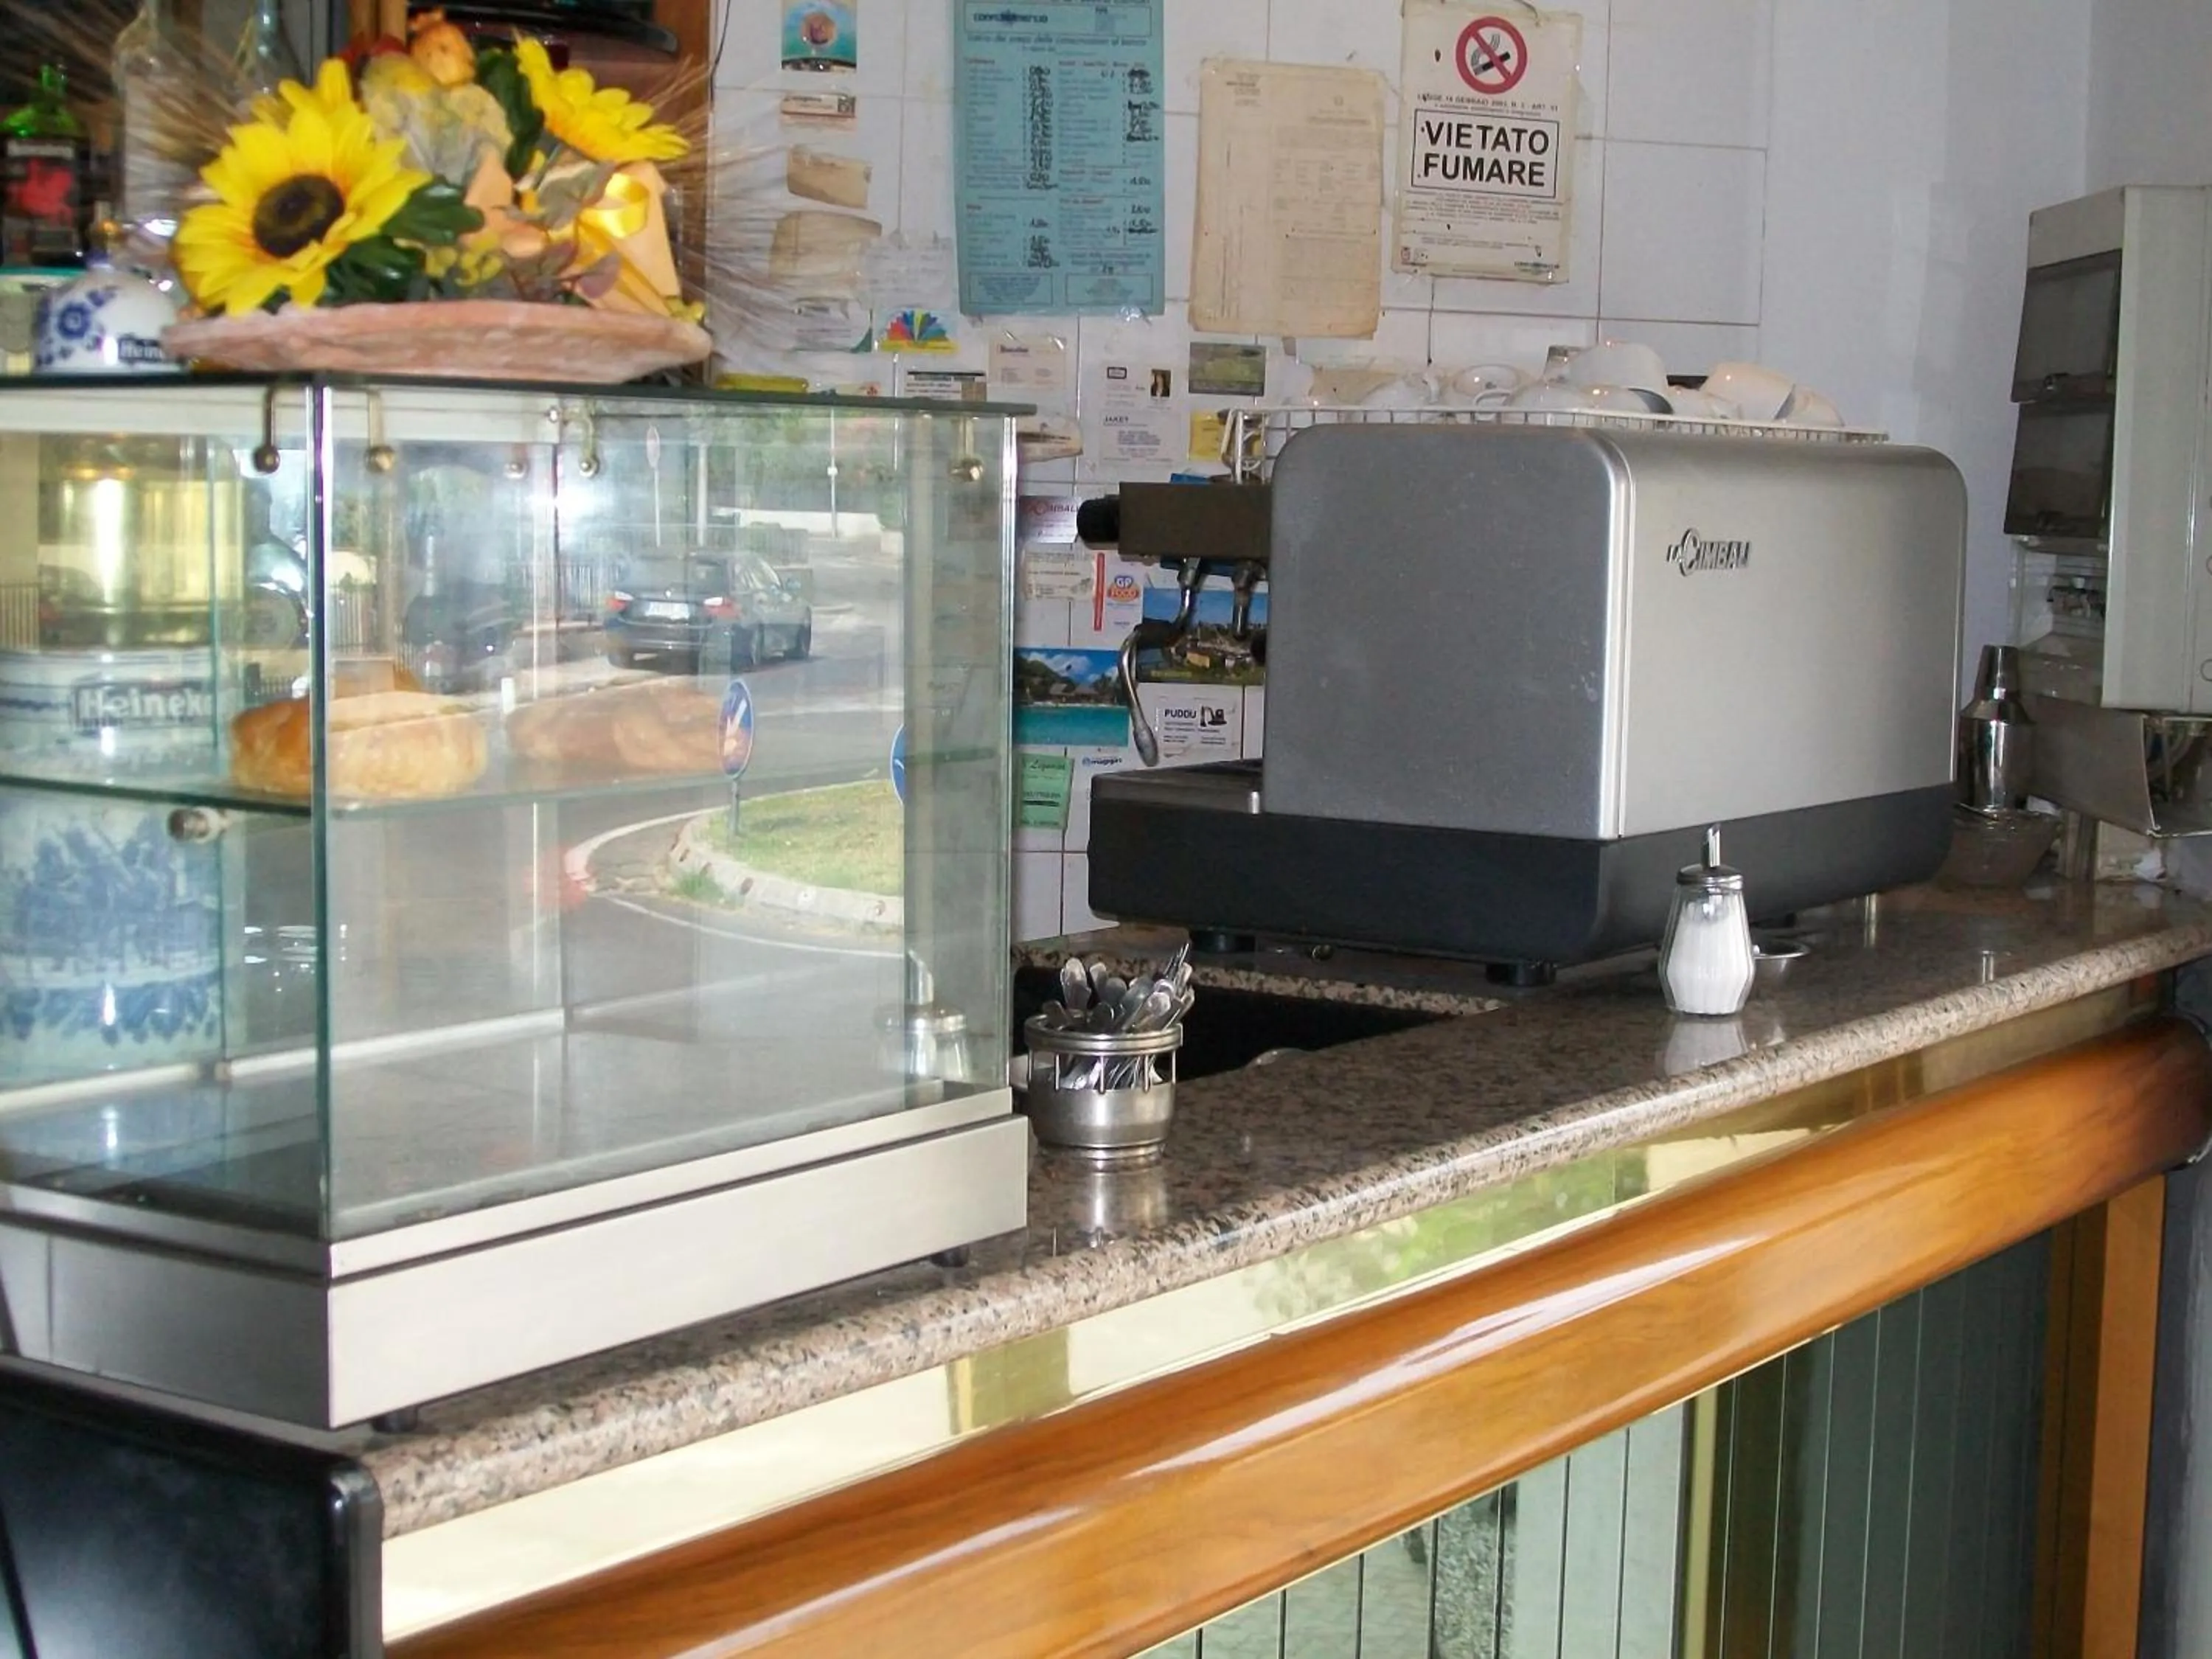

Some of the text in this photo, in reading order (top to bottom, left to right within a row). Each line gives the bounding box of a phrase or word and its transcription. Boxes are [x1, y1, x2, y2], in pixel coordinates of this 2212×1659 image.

[1425, 120, 1549, 156] VIETATO
[1423, 153, 1546, 187] FUMARE
[1164, 709, 1197, 719] PUDDU
